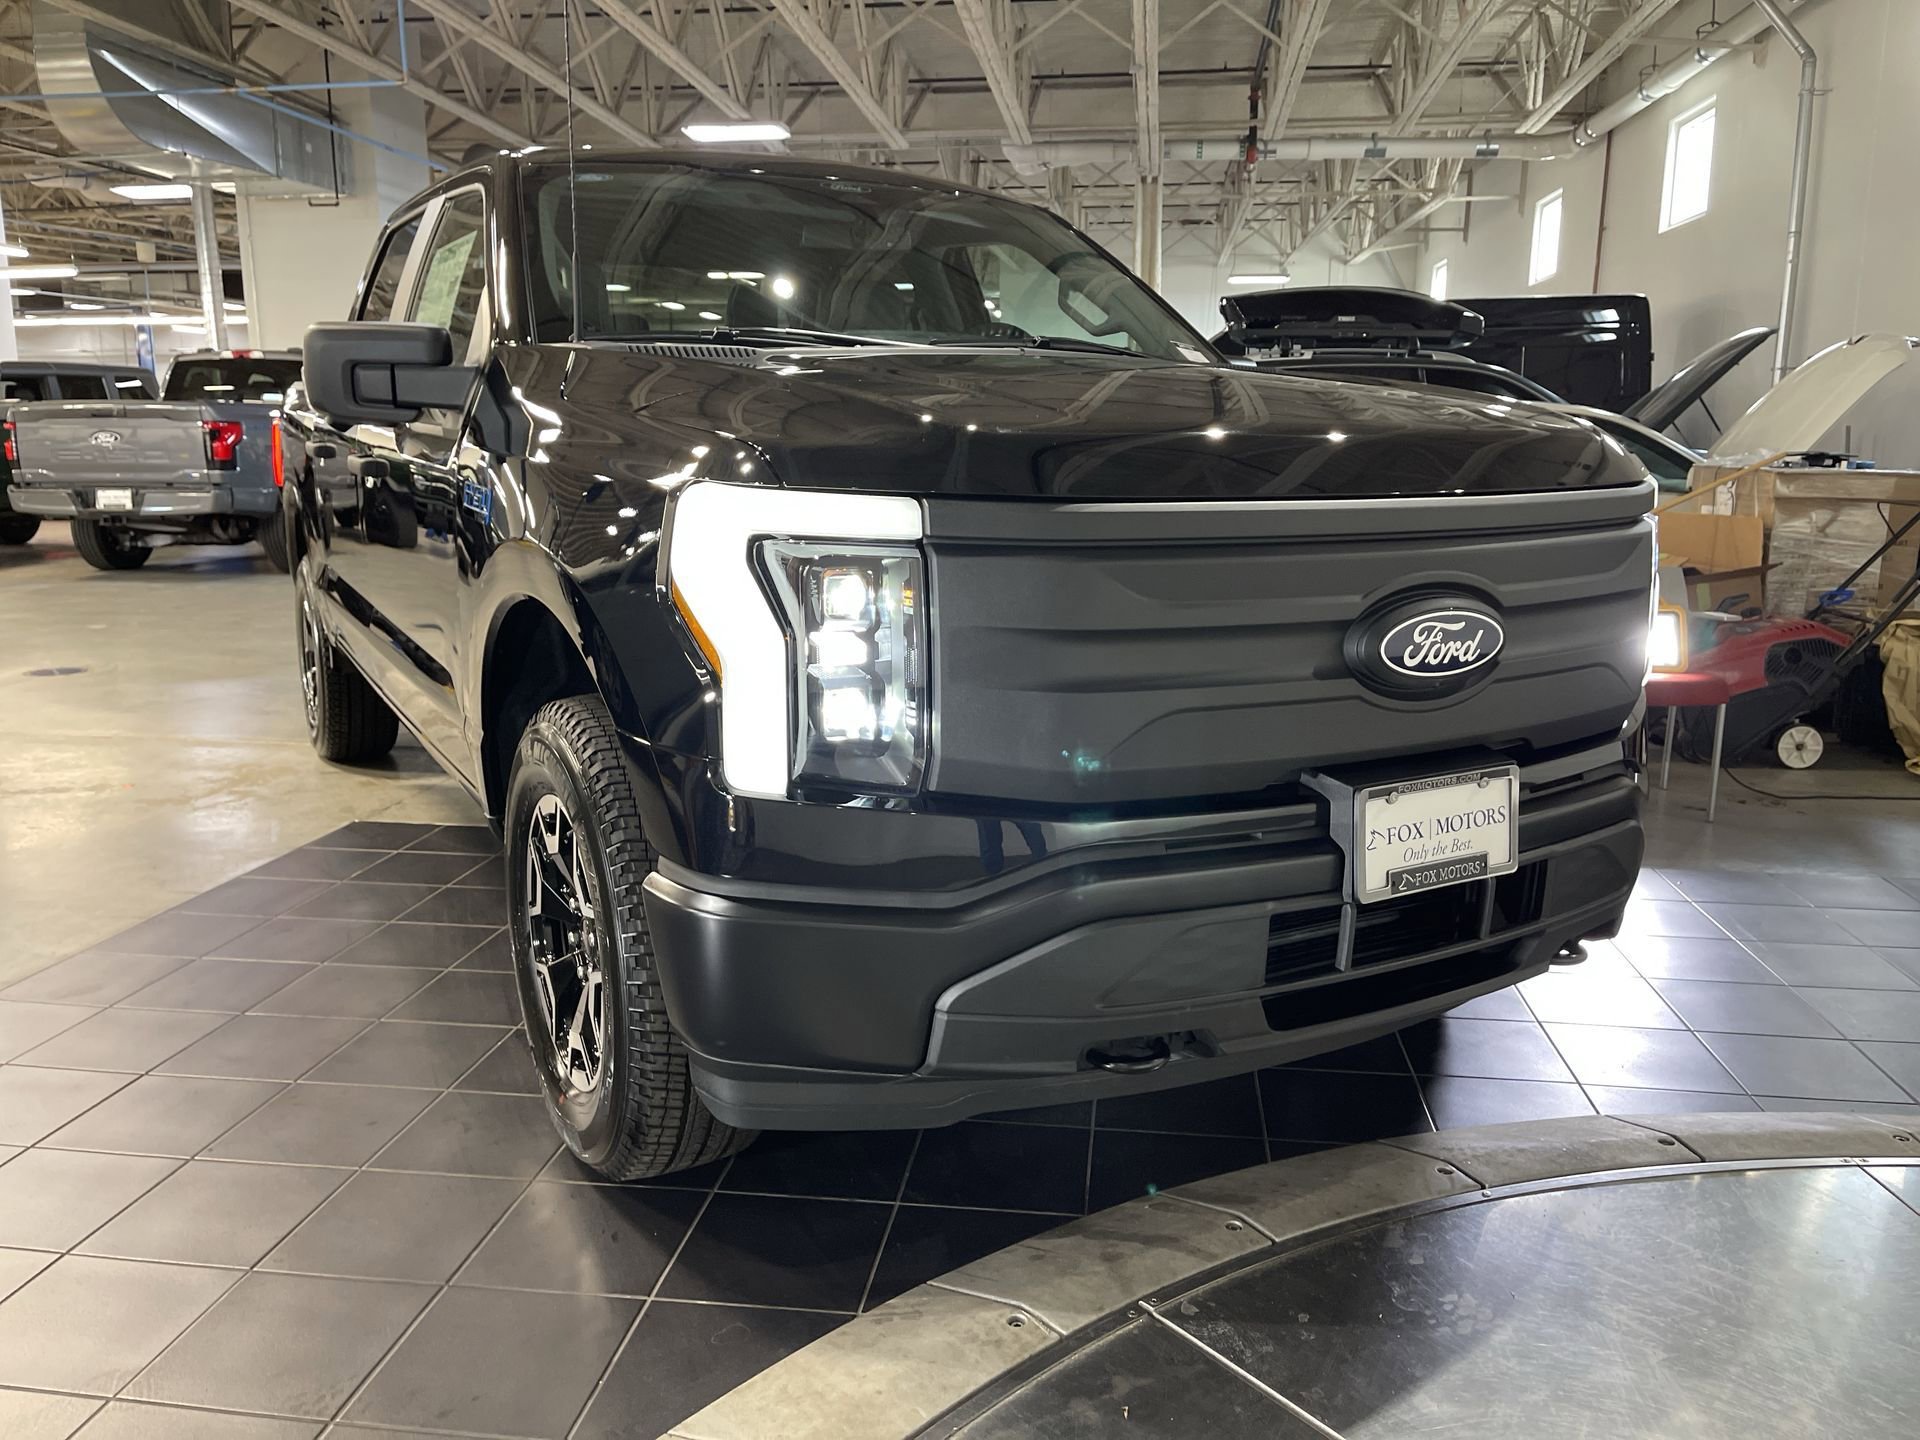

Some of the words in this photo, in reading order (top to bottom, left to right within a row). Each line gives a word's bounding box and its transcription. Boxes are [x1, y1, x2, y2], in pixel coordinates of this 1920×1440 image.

[1403, 621, 1484, 667] Ford
[1398, 773, 1481, 793] FOXMOTORS.COM
[1386, 821, 1424, 845] FOX
[1436, 805, 1506, 836] MOTORS
[1403, 845, 1430, 863] Only
[1432, 843, 1448, 857] the
[1451, 838, 1474, 854] Best.
[1415, 869, 1437, 886] FOX
[1439, 861, 1481, 881] MOTORS
